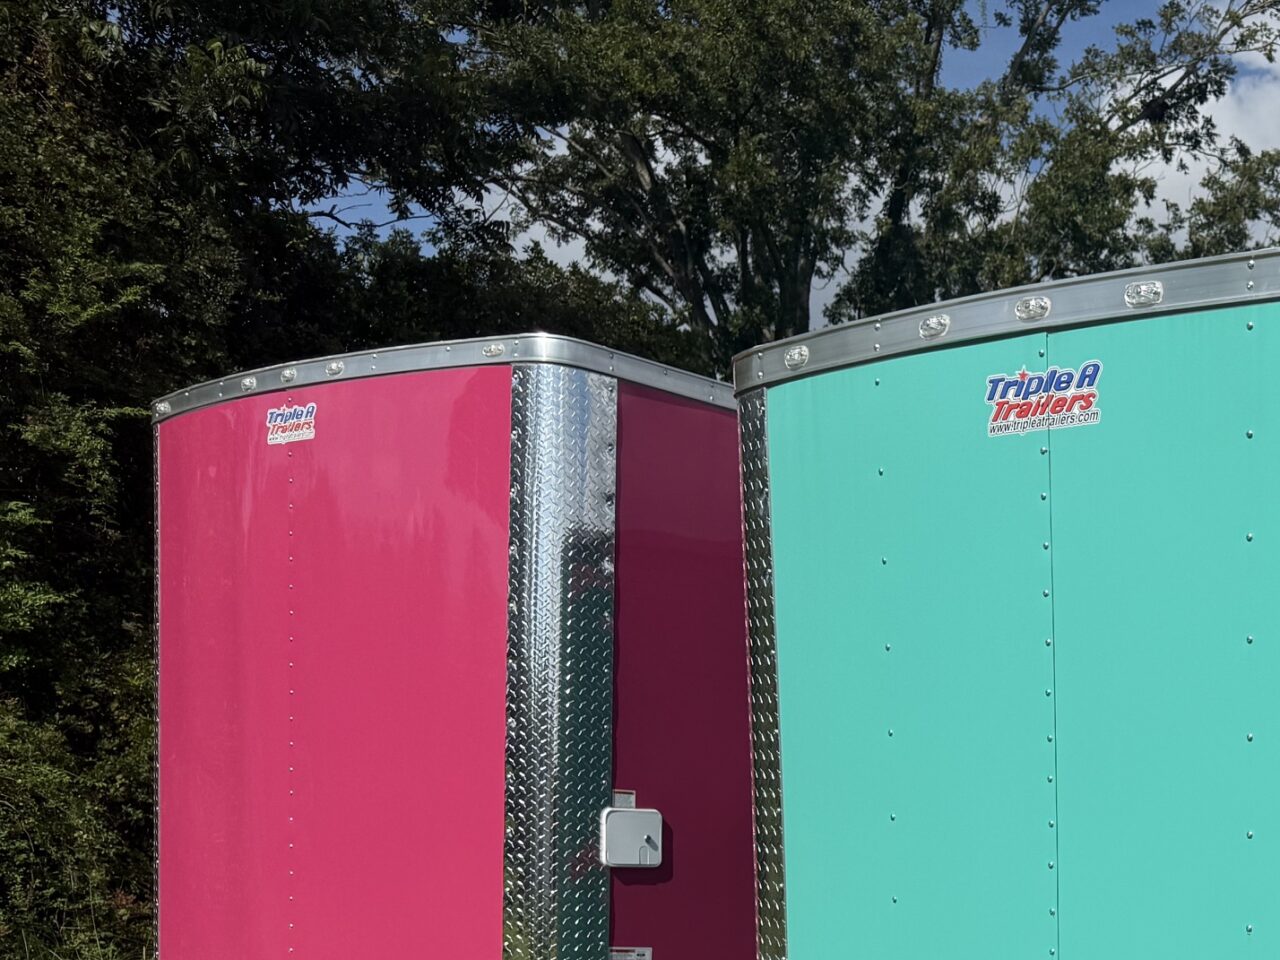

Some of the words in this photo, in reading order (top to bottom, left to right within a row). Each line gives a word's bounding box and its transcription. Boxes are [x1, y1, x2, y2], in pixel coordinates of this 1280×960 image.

[987, 369, 1074, 401] Triple
[1076, 362, 1101, 389] A
[268, 408, 304, 424] Triple
[304, 405, 315, 419] A
[991, 392, 1096, 423] Trailers
[270, 421, 313, 435] Trailers
[989, 411, 1099, 435] www.tripleatrailers.com
